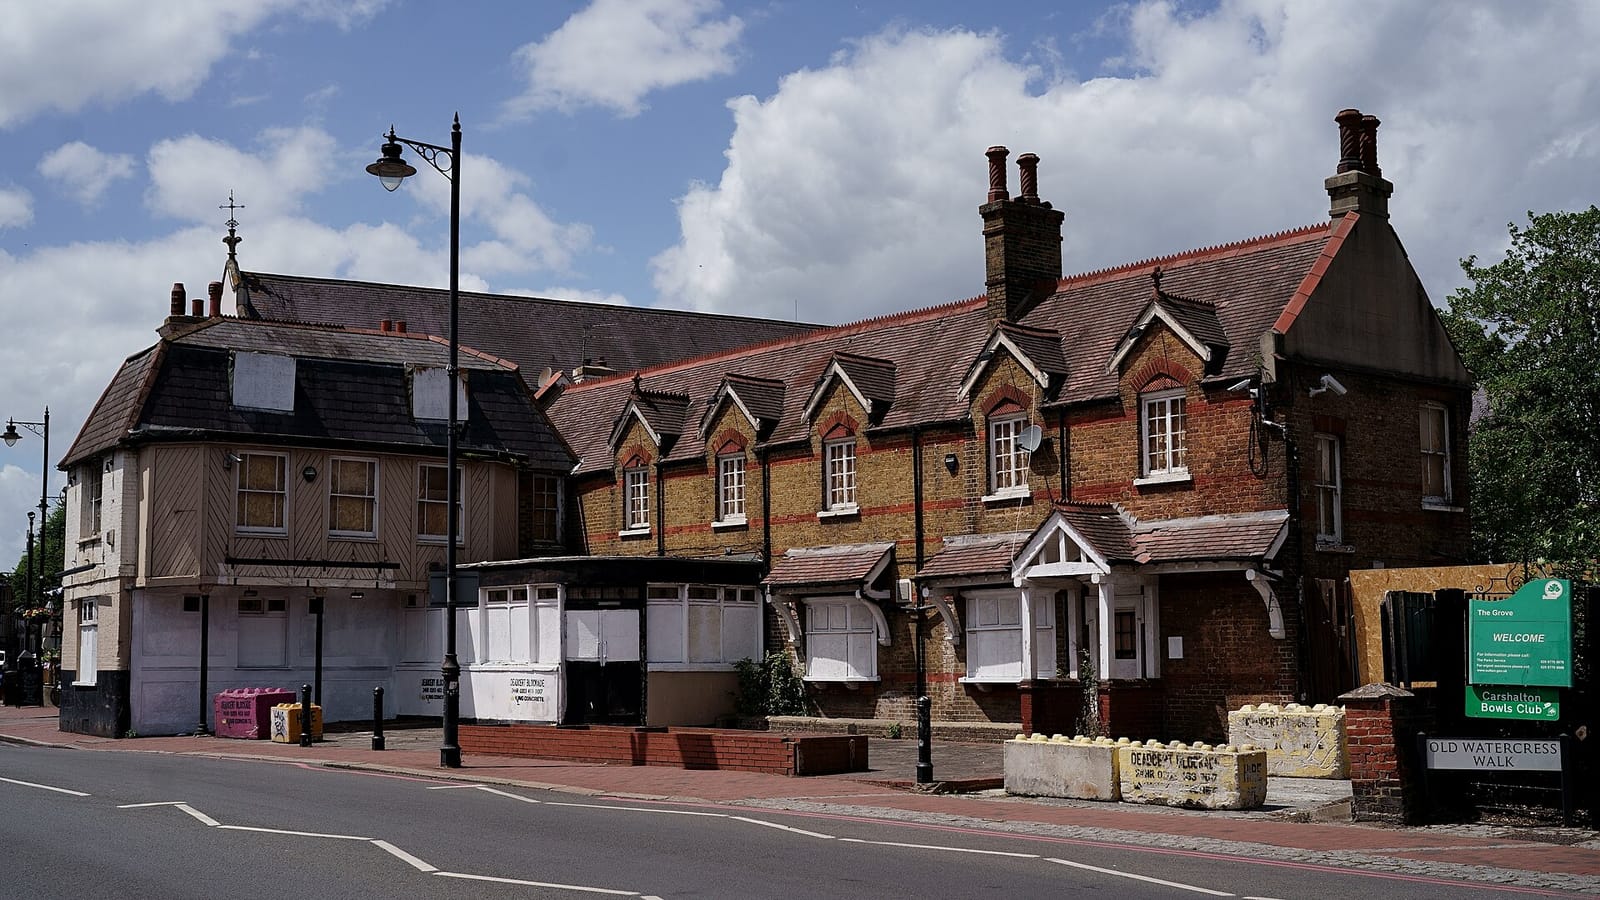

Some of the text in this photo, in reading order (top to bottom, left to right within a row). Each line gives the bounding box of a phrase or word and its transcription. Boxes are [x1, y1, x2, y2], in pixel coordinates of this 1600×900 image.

[1492, 609, 1514, 617] Grove
[1493, 633, 1545, 643] WELCOME
[1482, 691, 1541, 702] Carshalton
[1481, 702, 1542, 714] Bowls Club
[1429, 742, 1558, 754] OLD WATERCRESS
[1473, 756, 1514, 767] WALK
